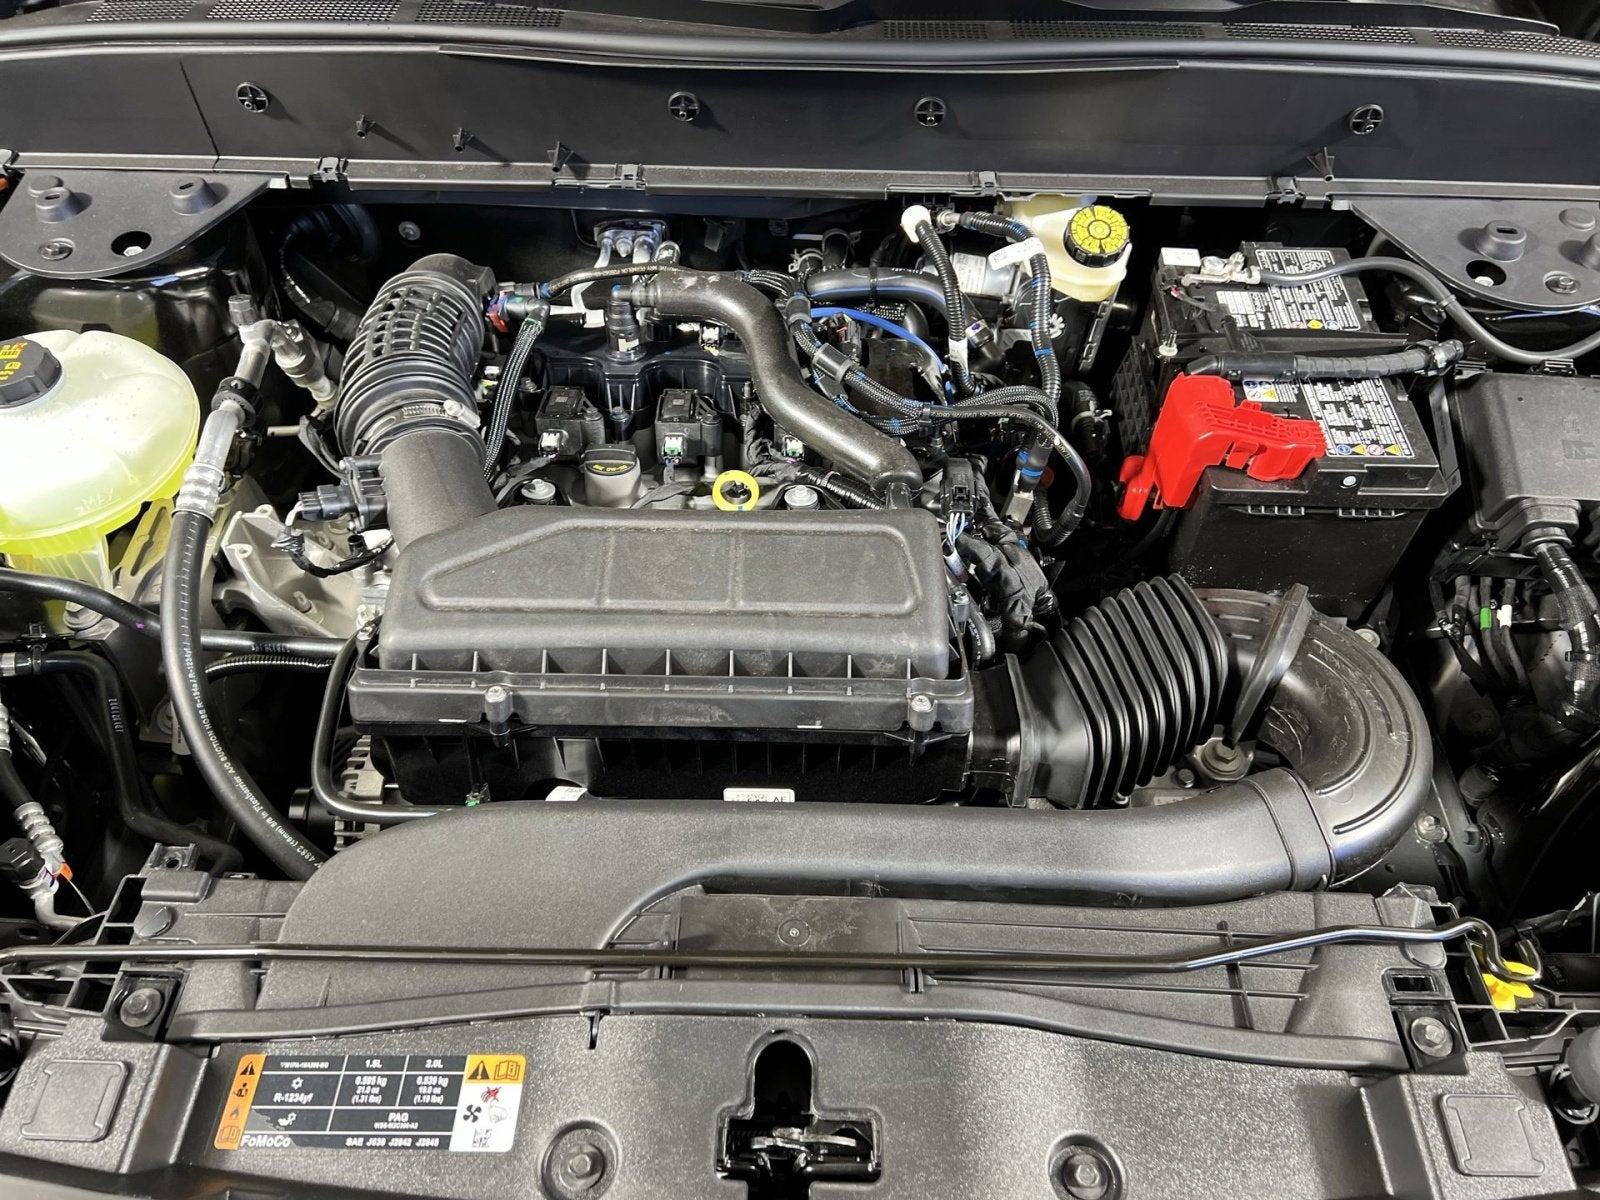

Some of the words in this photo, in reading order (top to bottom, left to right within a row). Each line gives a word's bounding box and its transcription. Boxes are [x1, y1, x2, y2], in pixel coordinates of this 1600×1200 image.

[199, 709, 213, 730] HOSE
[207, 731, 228, 761] SUCTION
[365, 1059, 382, 1068] 1.5L
[425, 1059, 443, 1068] 2.0L
[377, 1075, 388, 1088] kg
[438, 1075, 449, 1088] kg
[272, 1092, 314, 1105] R-1234yf
[388, 1112, 409, 1122] PAG
[240, 1134, 291, 1147] FoMoCo
